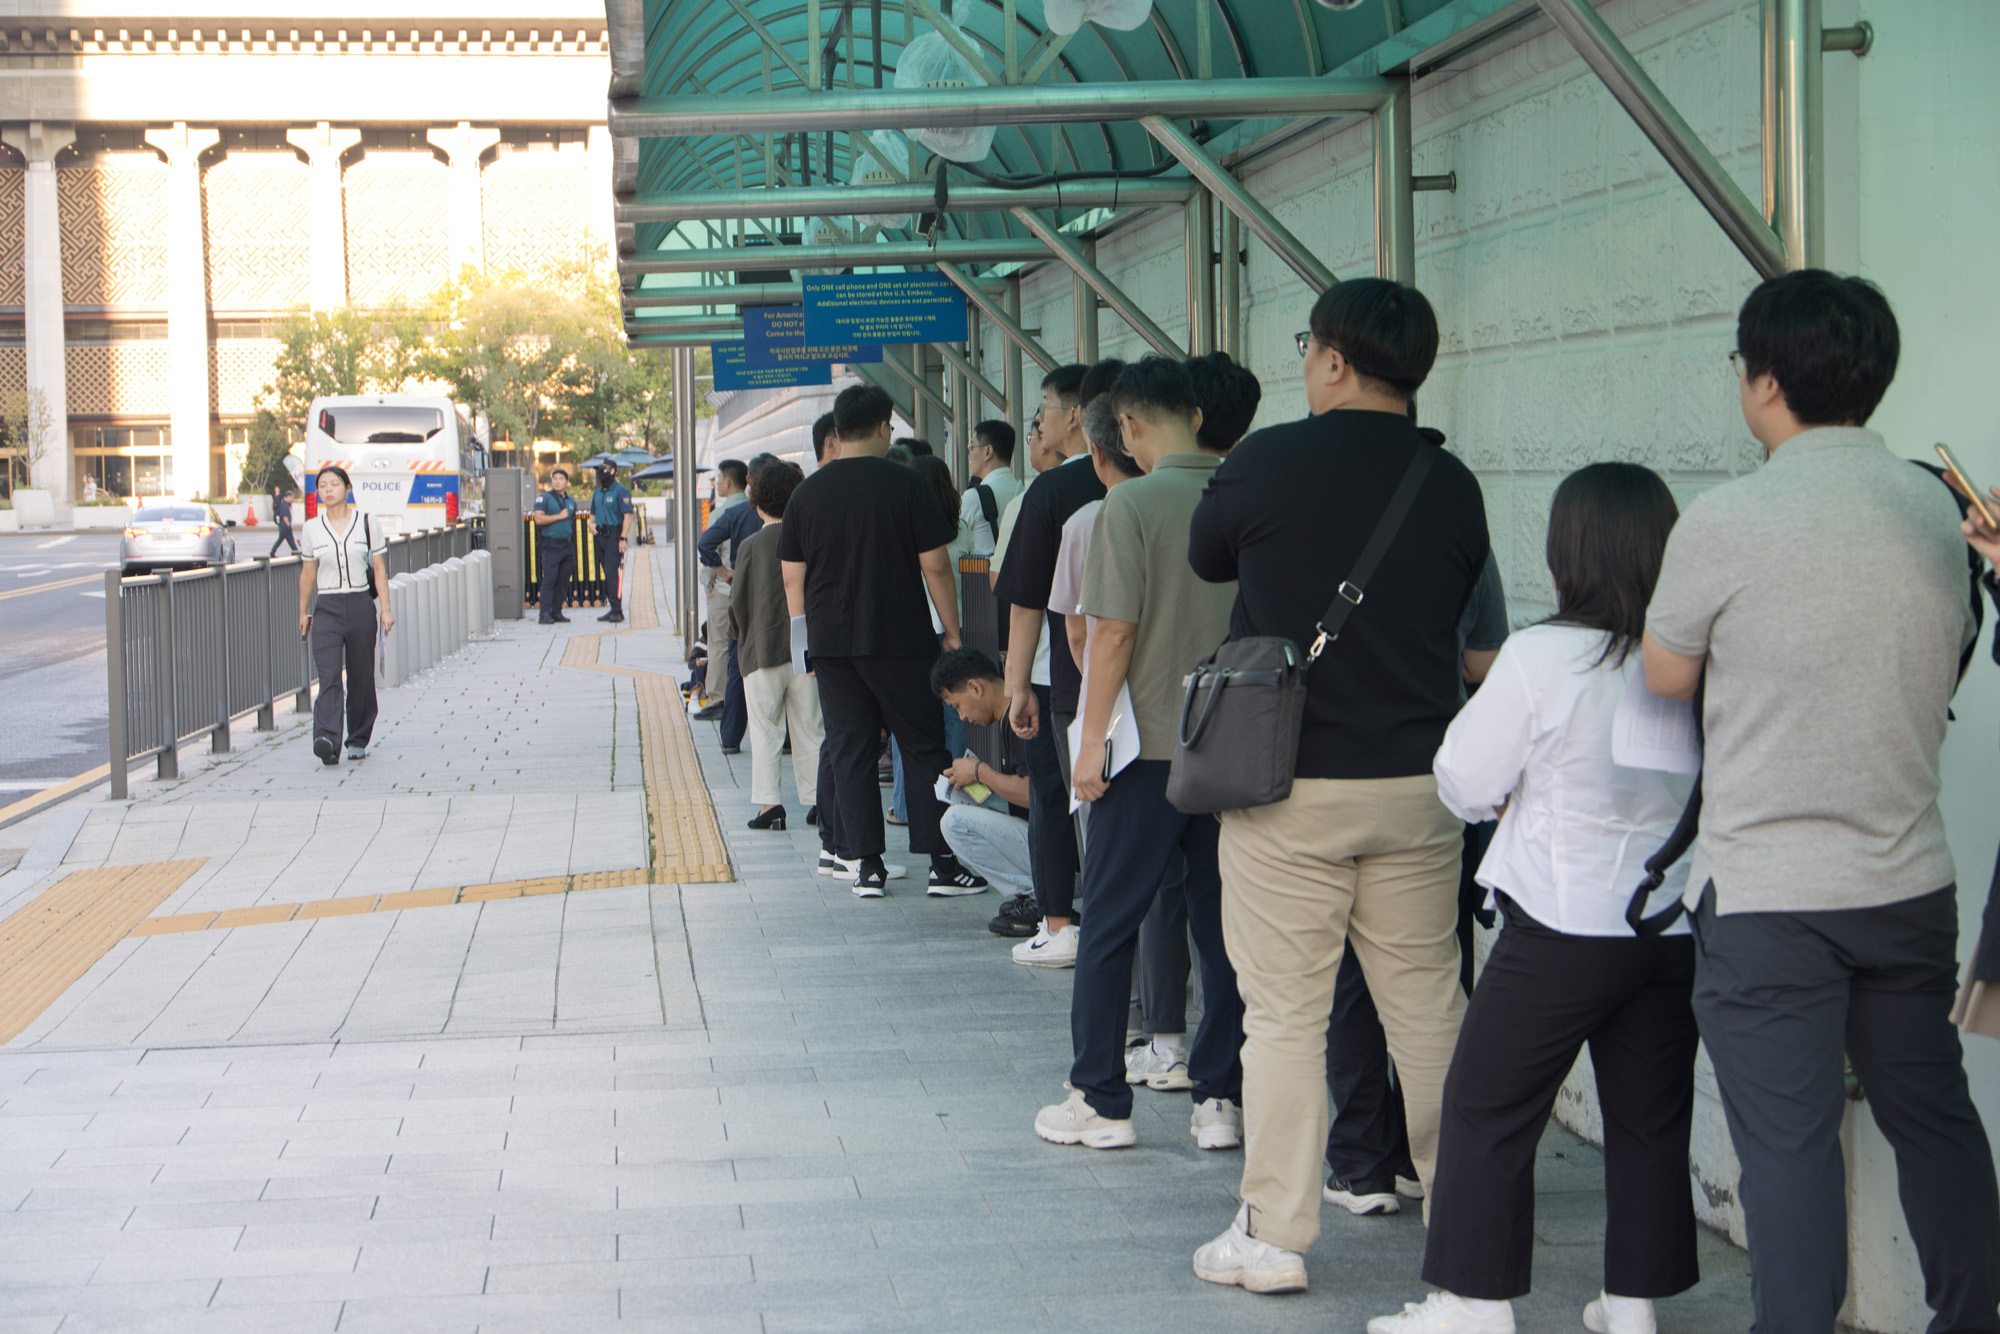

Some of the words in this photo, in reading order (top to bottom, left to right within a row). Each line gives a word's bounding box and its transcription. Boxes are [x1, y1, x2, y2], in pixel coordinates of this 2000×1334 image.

[846, 283, 865, 291] phone
[923, 296, 954, 304] permitted.
[776, 311, 803, 319] America
[783, 320, 798, 328] NOT
[362, 481, 401, 491] POLICE
